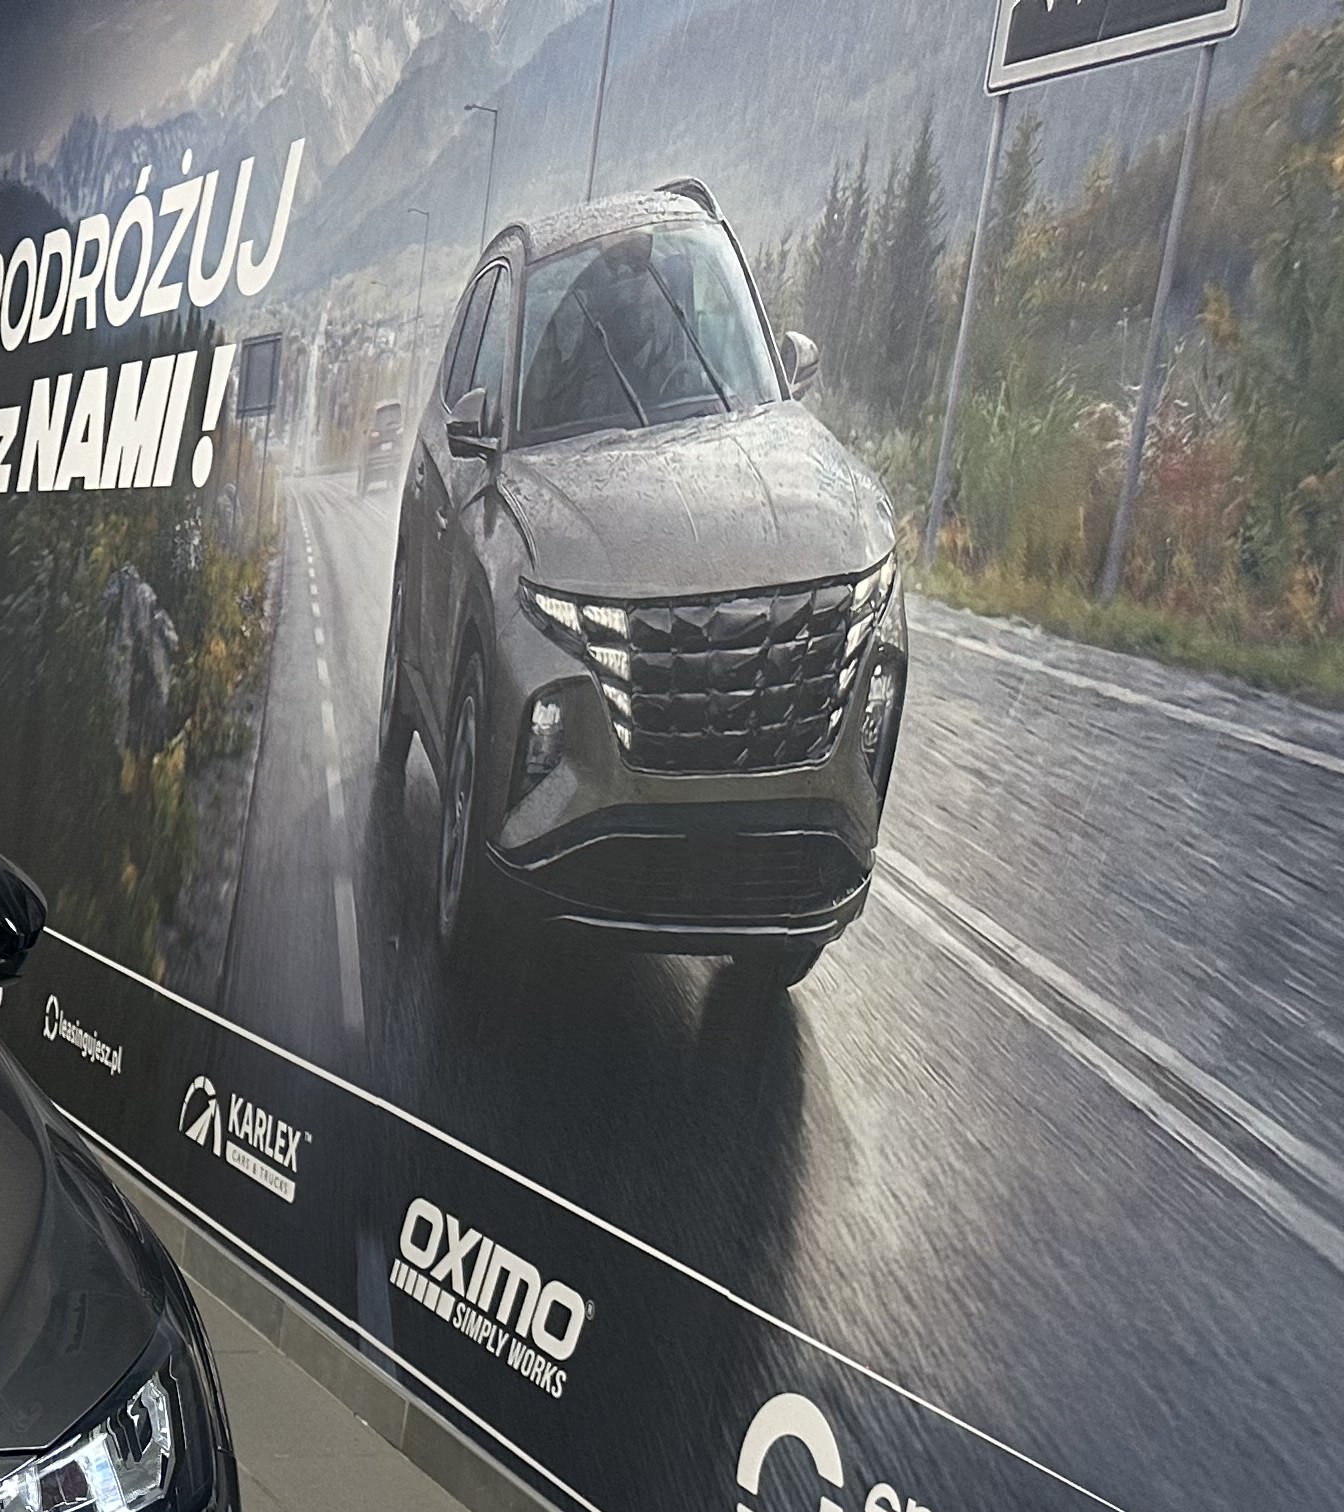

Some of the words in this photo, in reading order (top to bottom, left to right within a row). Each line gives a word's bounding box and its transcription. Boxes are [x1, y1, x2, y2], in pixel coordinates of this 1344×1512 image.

[58, 1009, 123, 1076] leasingujesz.pl
[231, 1148, 251, 1171] CARS
[260, 1166, 289, 1196] TRUCKS
[452, 1301, 510, 1359] SIMPLY
[506, 1337, 568, 1400] WORKS
